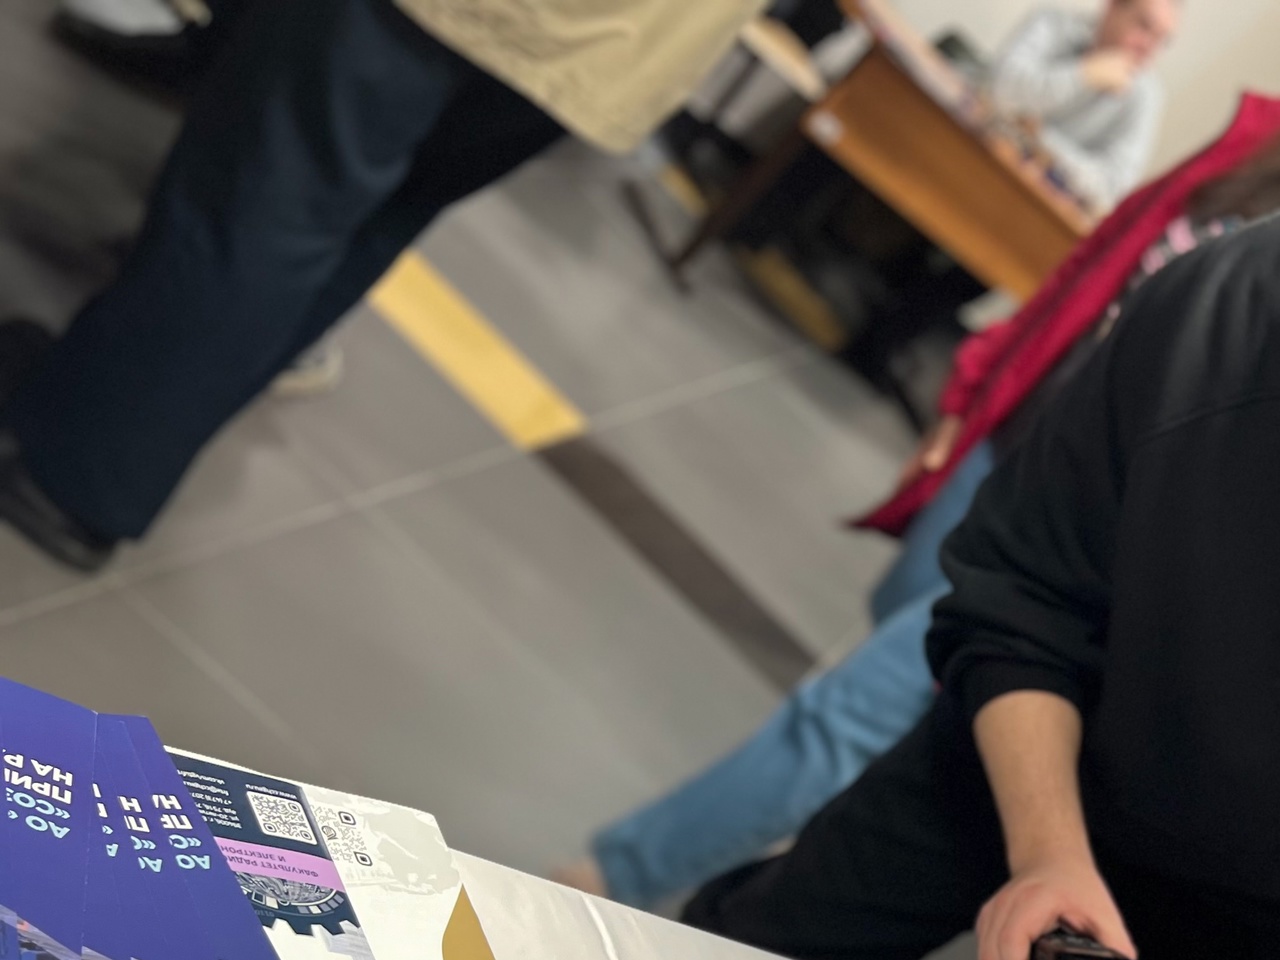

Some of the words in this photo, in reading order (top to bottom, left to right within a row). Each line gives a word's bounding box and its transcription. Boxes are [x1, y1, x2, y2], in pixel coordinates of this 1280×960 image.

[31, 759, 73, 785] НА
[25, 815, 70, 838] АО
[176, 854, 210, 869] АО
[261, 861, 318, 877] ФАКУЛЬТЕТ
